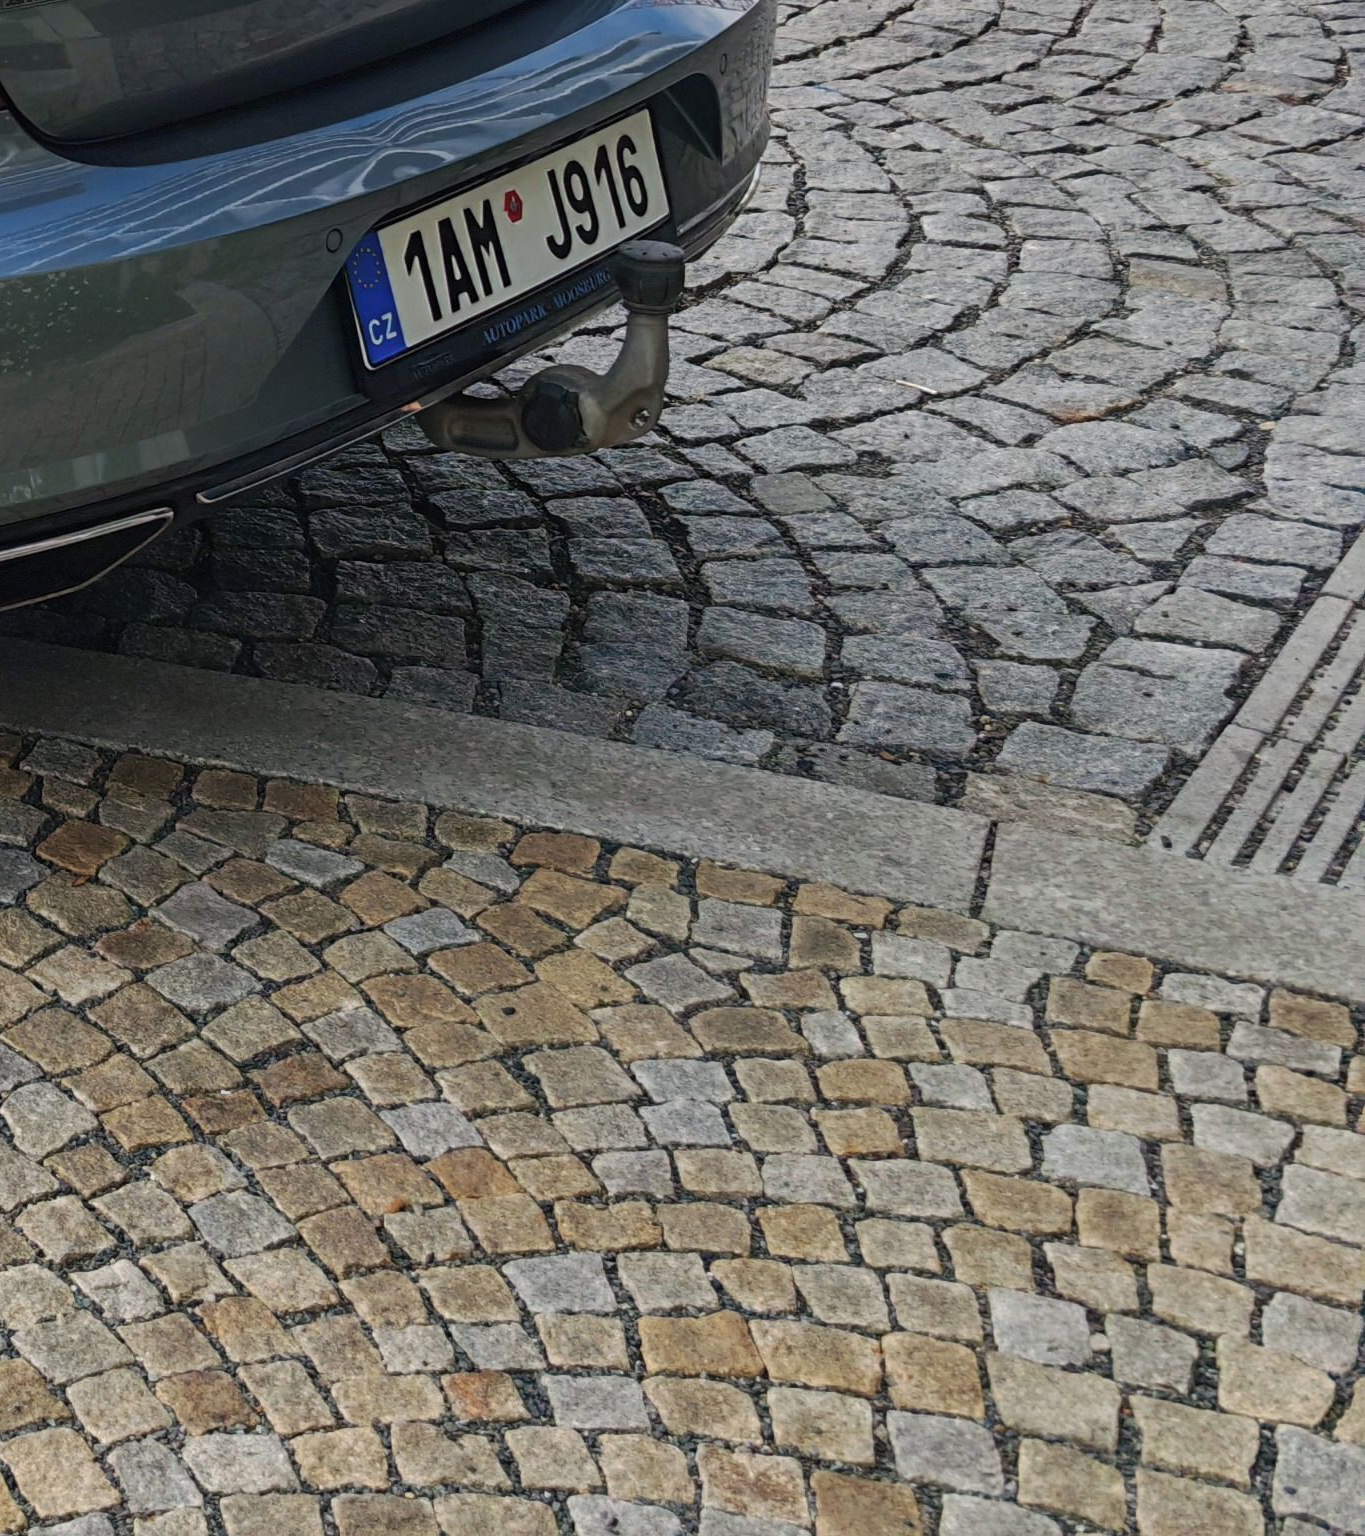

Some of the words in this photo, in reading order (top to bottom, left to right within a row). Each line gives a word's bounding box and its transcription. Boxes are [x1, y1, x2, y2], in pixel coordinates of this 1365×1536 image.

[369, 311, 397, 345] CZ
[403, 199, 512, 321] 1AM
[545, 134, 649, 260] J916
